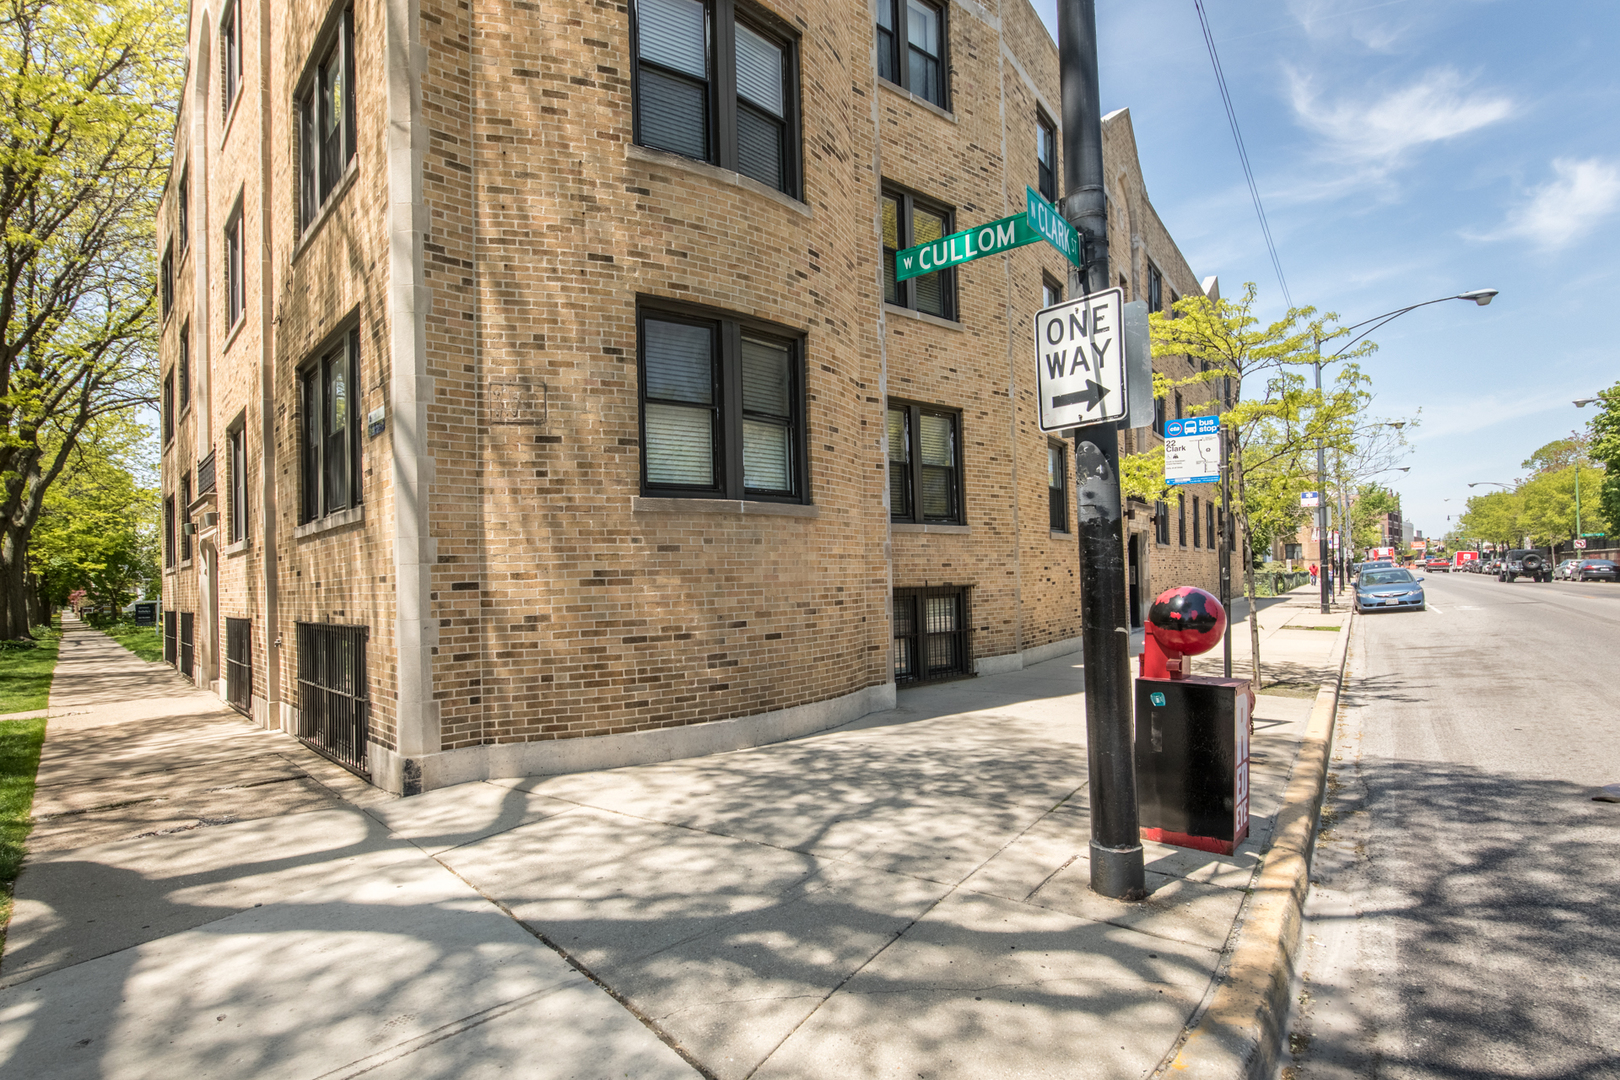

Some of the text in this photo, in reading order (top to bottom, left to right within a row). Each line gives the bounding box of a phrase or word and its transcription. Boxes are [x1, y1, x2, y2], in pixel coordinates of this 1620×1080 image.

[903, 220, 1015, 270] W CULLOM
[1031, 200, 1077, 256] N CLARK ST
[1046, 303, 1110, 346] ONE
[1045, 338, 1112, 380] WAY
